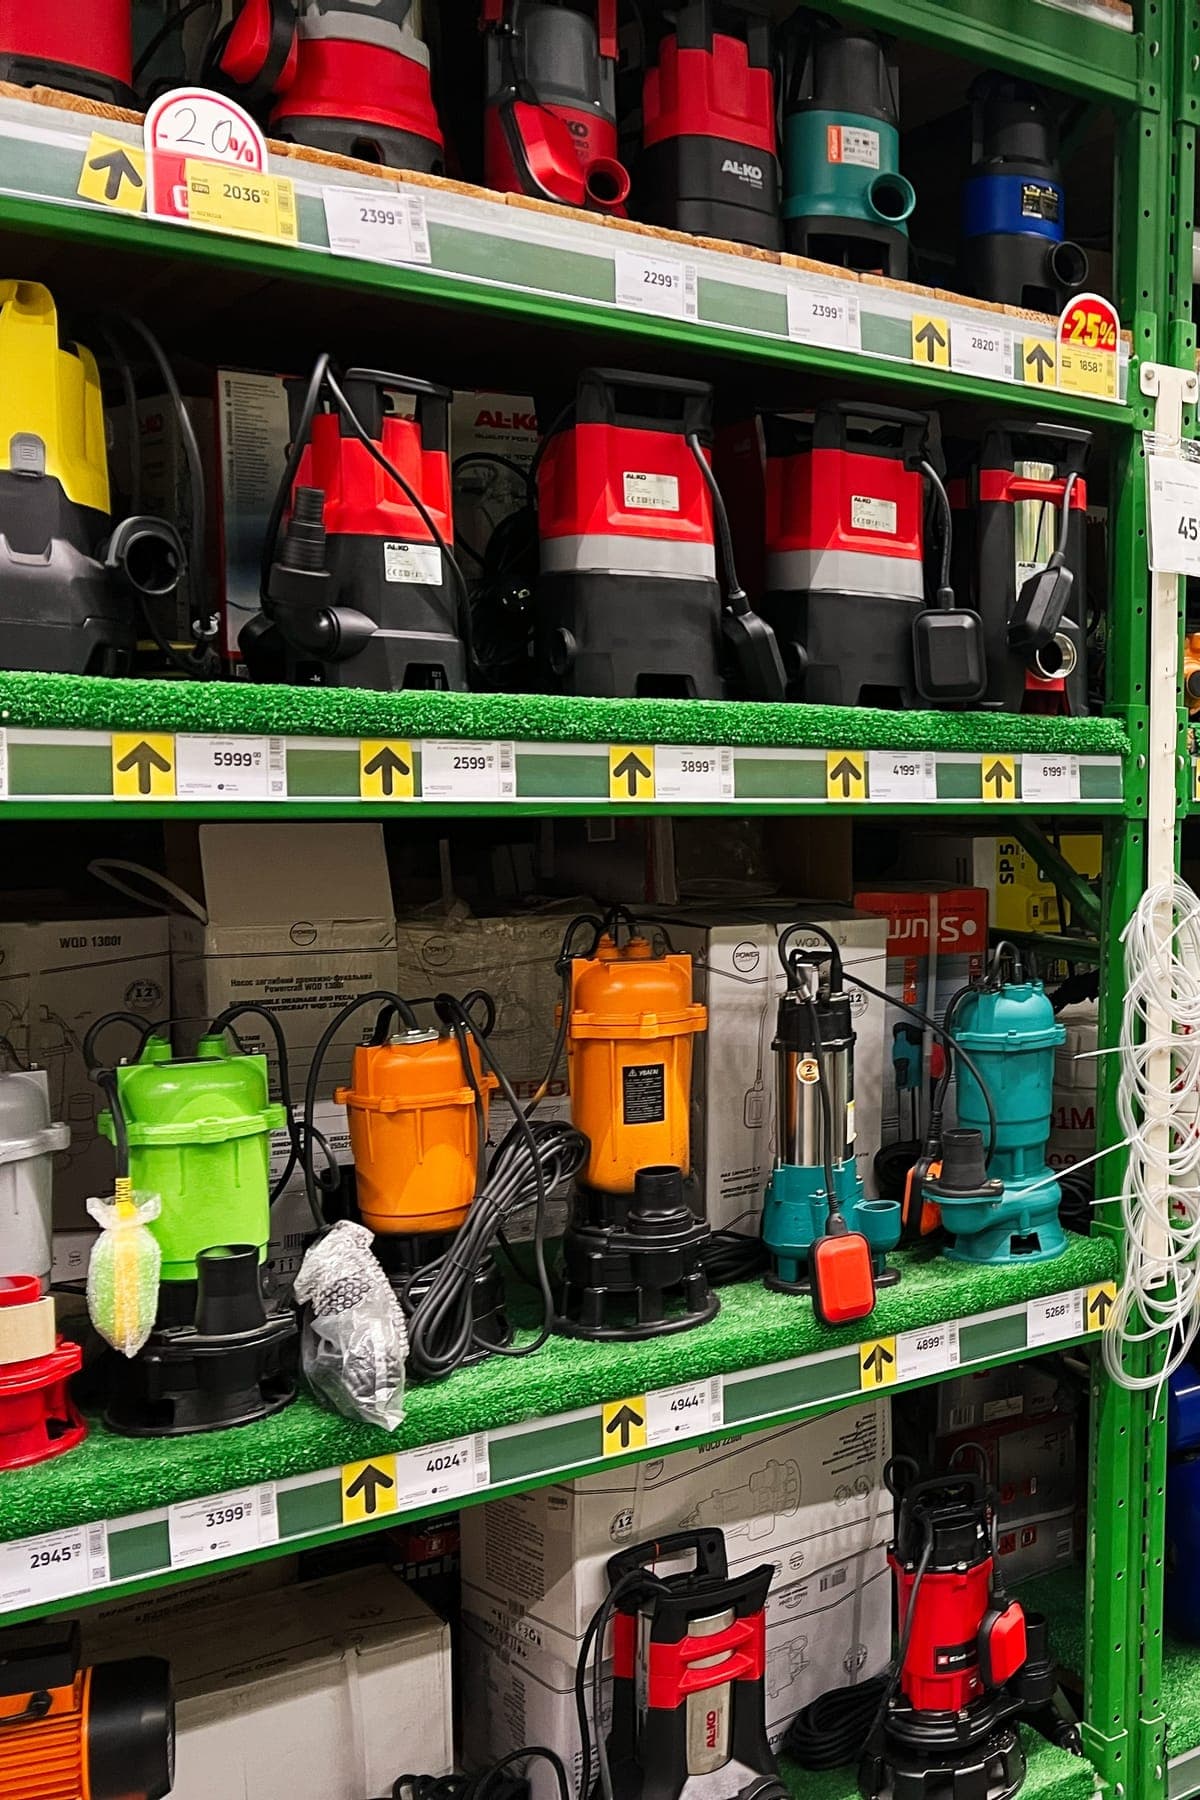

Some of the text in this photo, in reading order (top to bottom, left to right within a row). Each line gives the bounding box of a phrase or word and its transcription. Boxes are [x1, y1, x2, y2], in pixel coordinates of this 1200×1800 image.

[223, 184, 261, 203] 2036
[359, 208, 395, 226] 2399
[643, 271, 672, 288] 2299
[812, 304, 838, 319] 2399
[1063, 310, 1116, 347] -25%
[971, 337, 994, 351] 2820
[1079, 359, 1098, 374] 1858
[1178, 516, 1198, 541] 45
[213, 751, 253, 767] 5999
[453, 756, 486, 770] 2599
[681, 760, 710, 774] 3899
[893, 764, 915, 777] 4199
[1042, 766, 1063, 778] 6199
[59, 937, 87, 948] WQD
[1045, 1305, 1065, 1319] 5268
[916, 1336, 940, 1351] 4899
[670, 1395, 699, 1412] 4944
[425, 1453, 460, 1473] 4024
[205, 1506, 244, 1528] 3399
[29, 1547, 71, 1570] 2945
